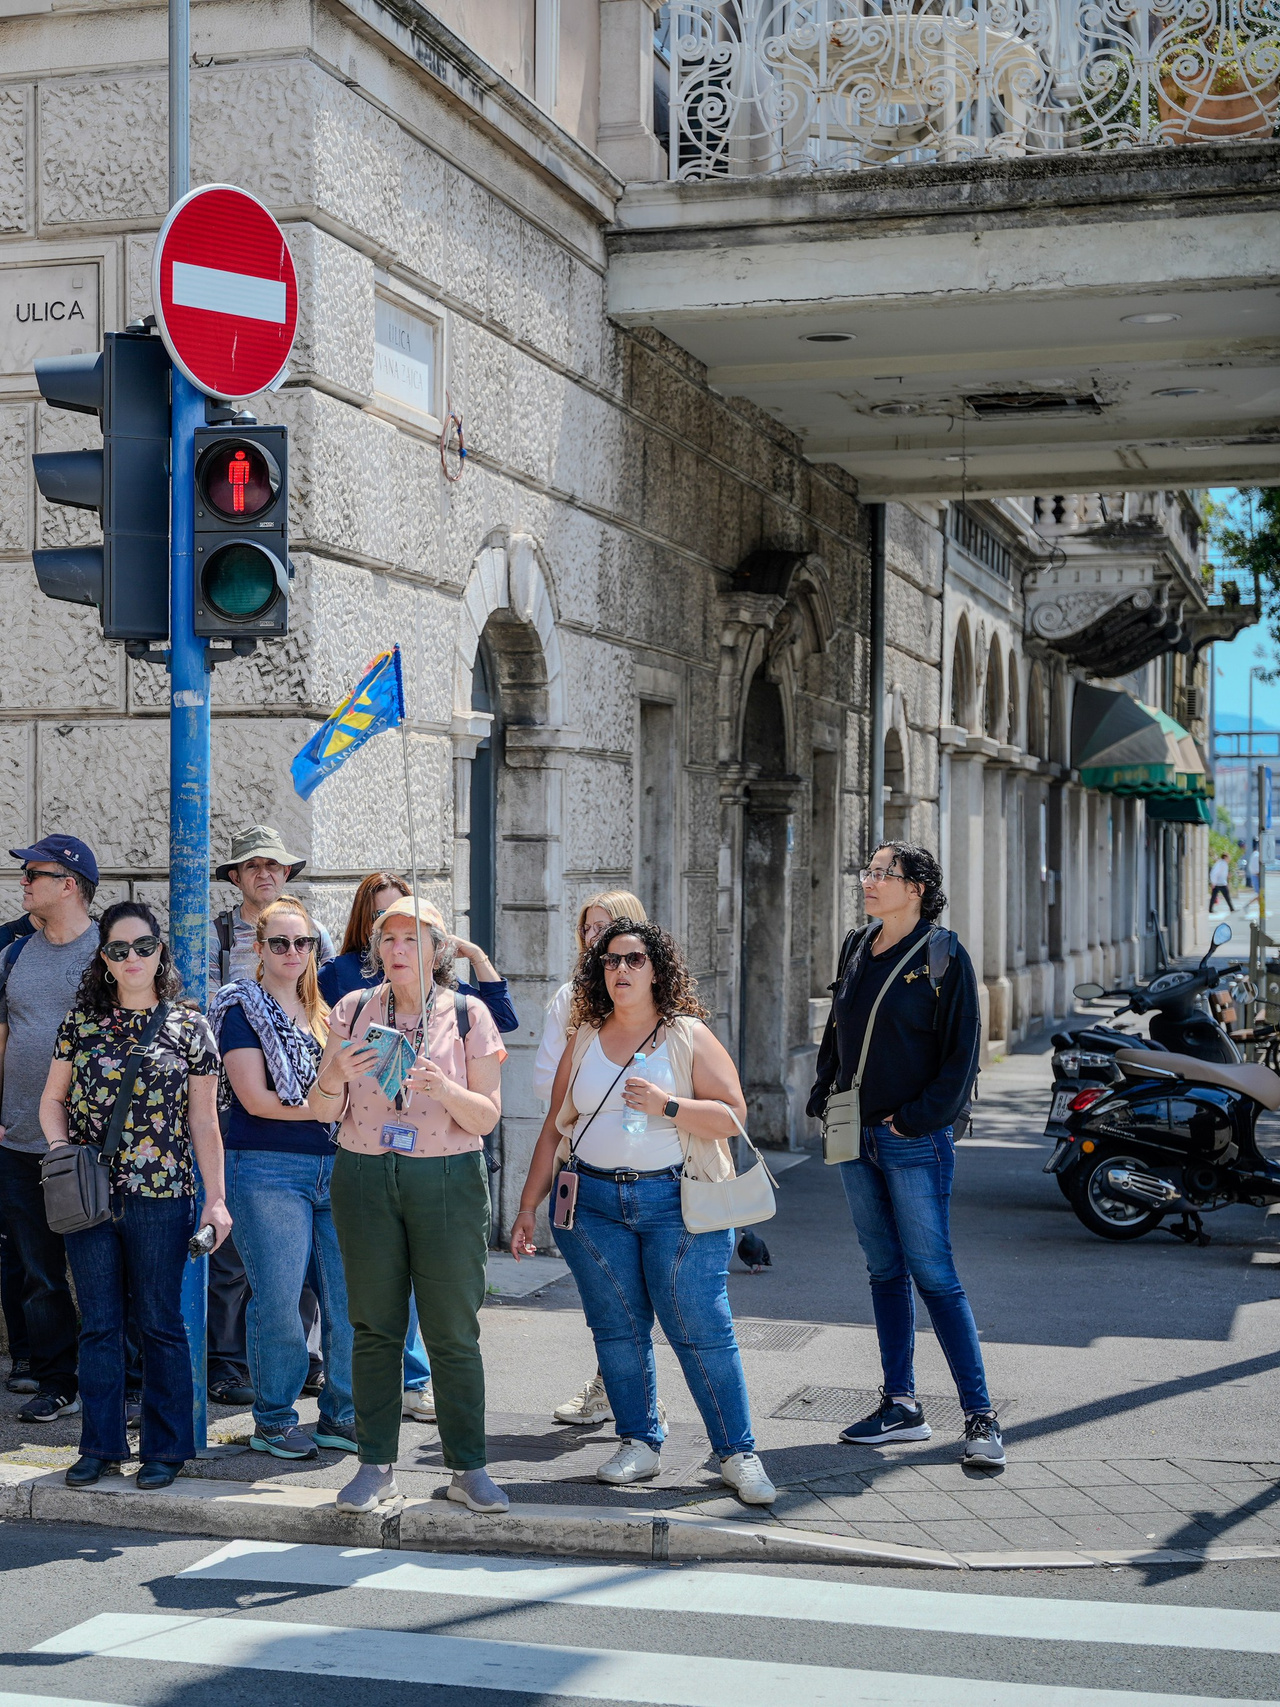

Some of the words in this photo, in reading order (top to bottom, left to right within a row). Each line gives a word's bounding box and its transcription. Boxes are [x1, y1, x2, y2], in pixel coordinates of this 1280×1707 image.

[16, 300, 85, 323] ULICA
[388, 323, 411, 352] ULICA
[376, 351, 399, 379] IVANA
[401, 364, 423, 391] ZAJCA
